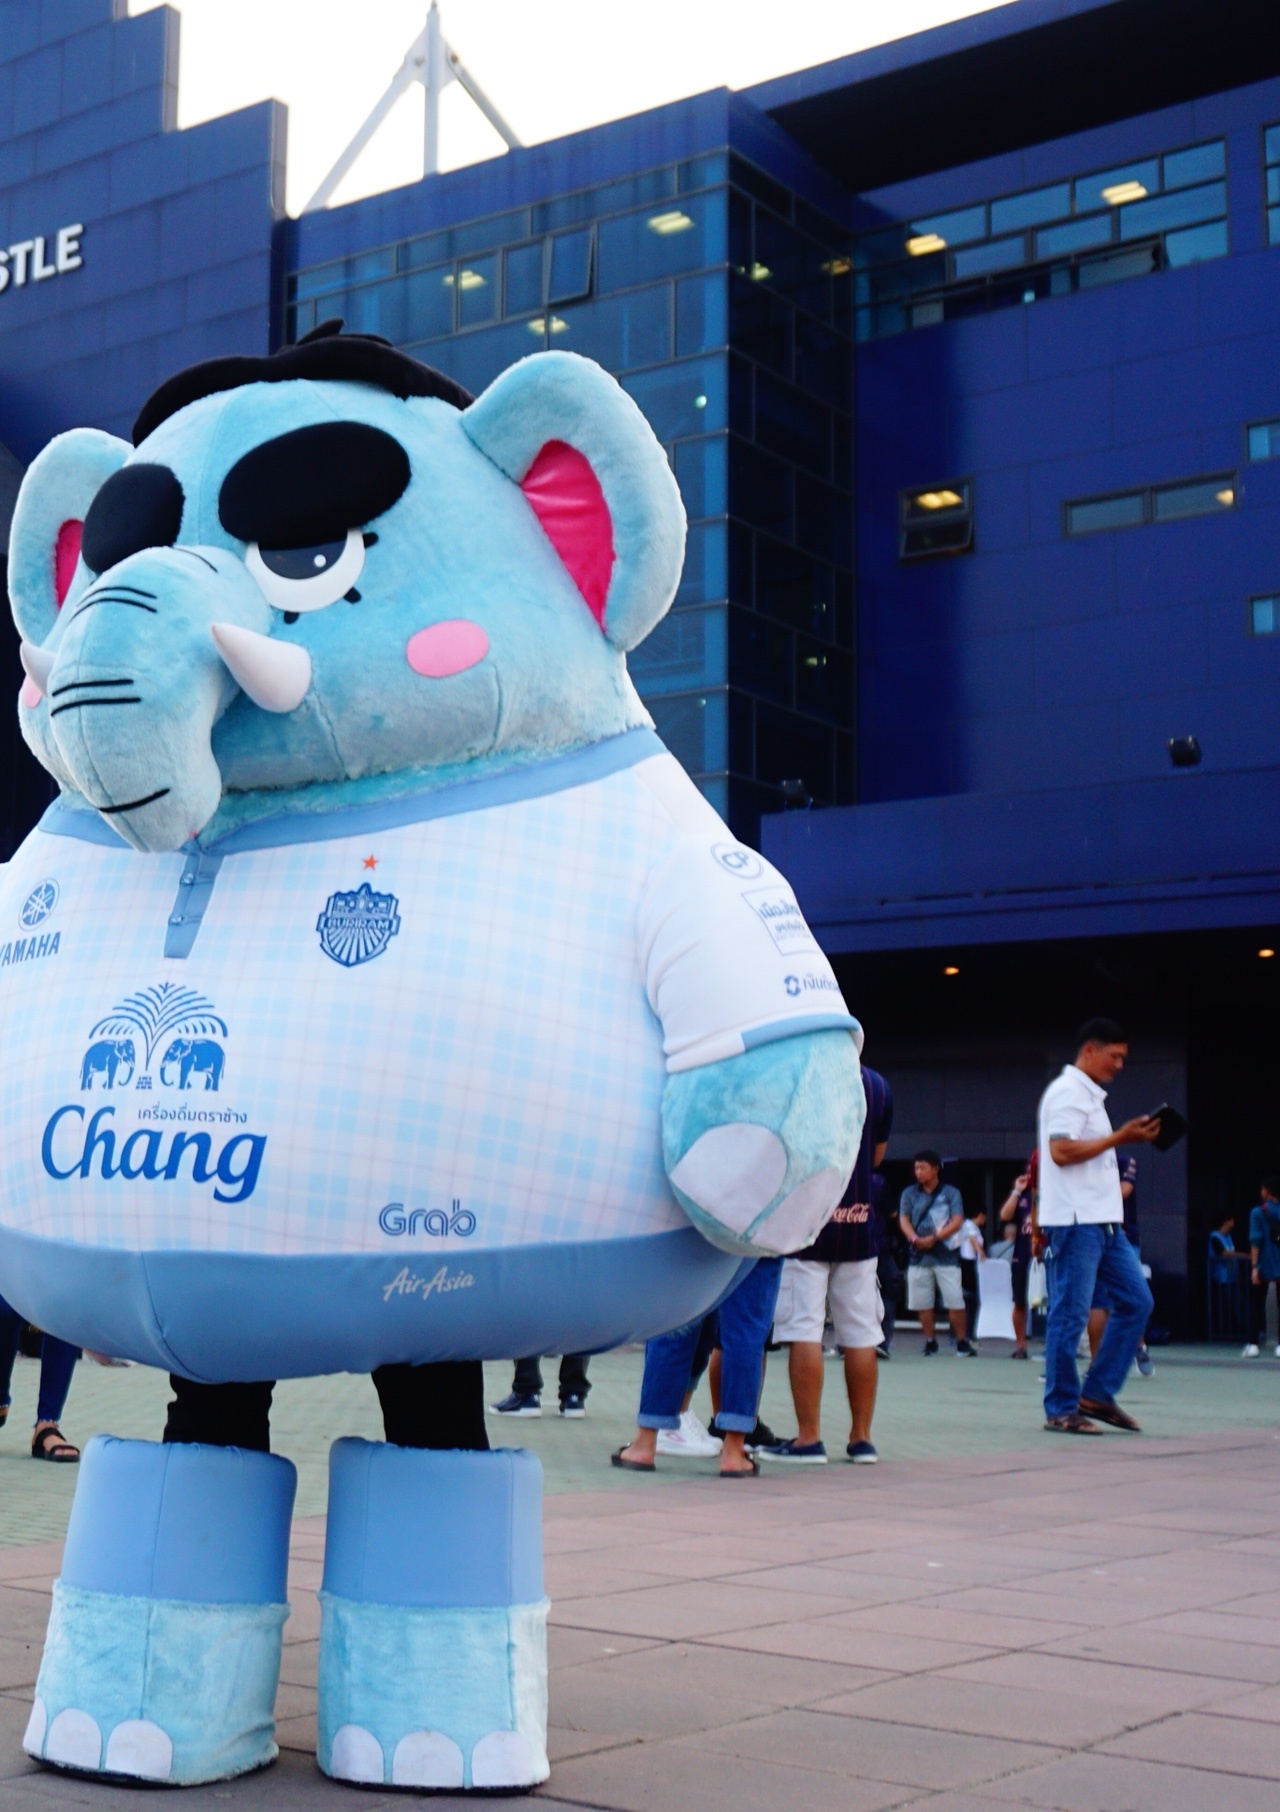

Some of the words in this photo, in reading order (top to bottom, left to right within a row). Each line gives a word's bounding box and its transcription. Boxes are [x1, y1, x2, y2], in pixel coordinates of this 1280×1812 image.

[138, 1101, 248, 1123] เครื่องดื่มตราช้าง
[41, 1104, 268, 1203] Chang
[379, 1199, 476, 1237] Grab
